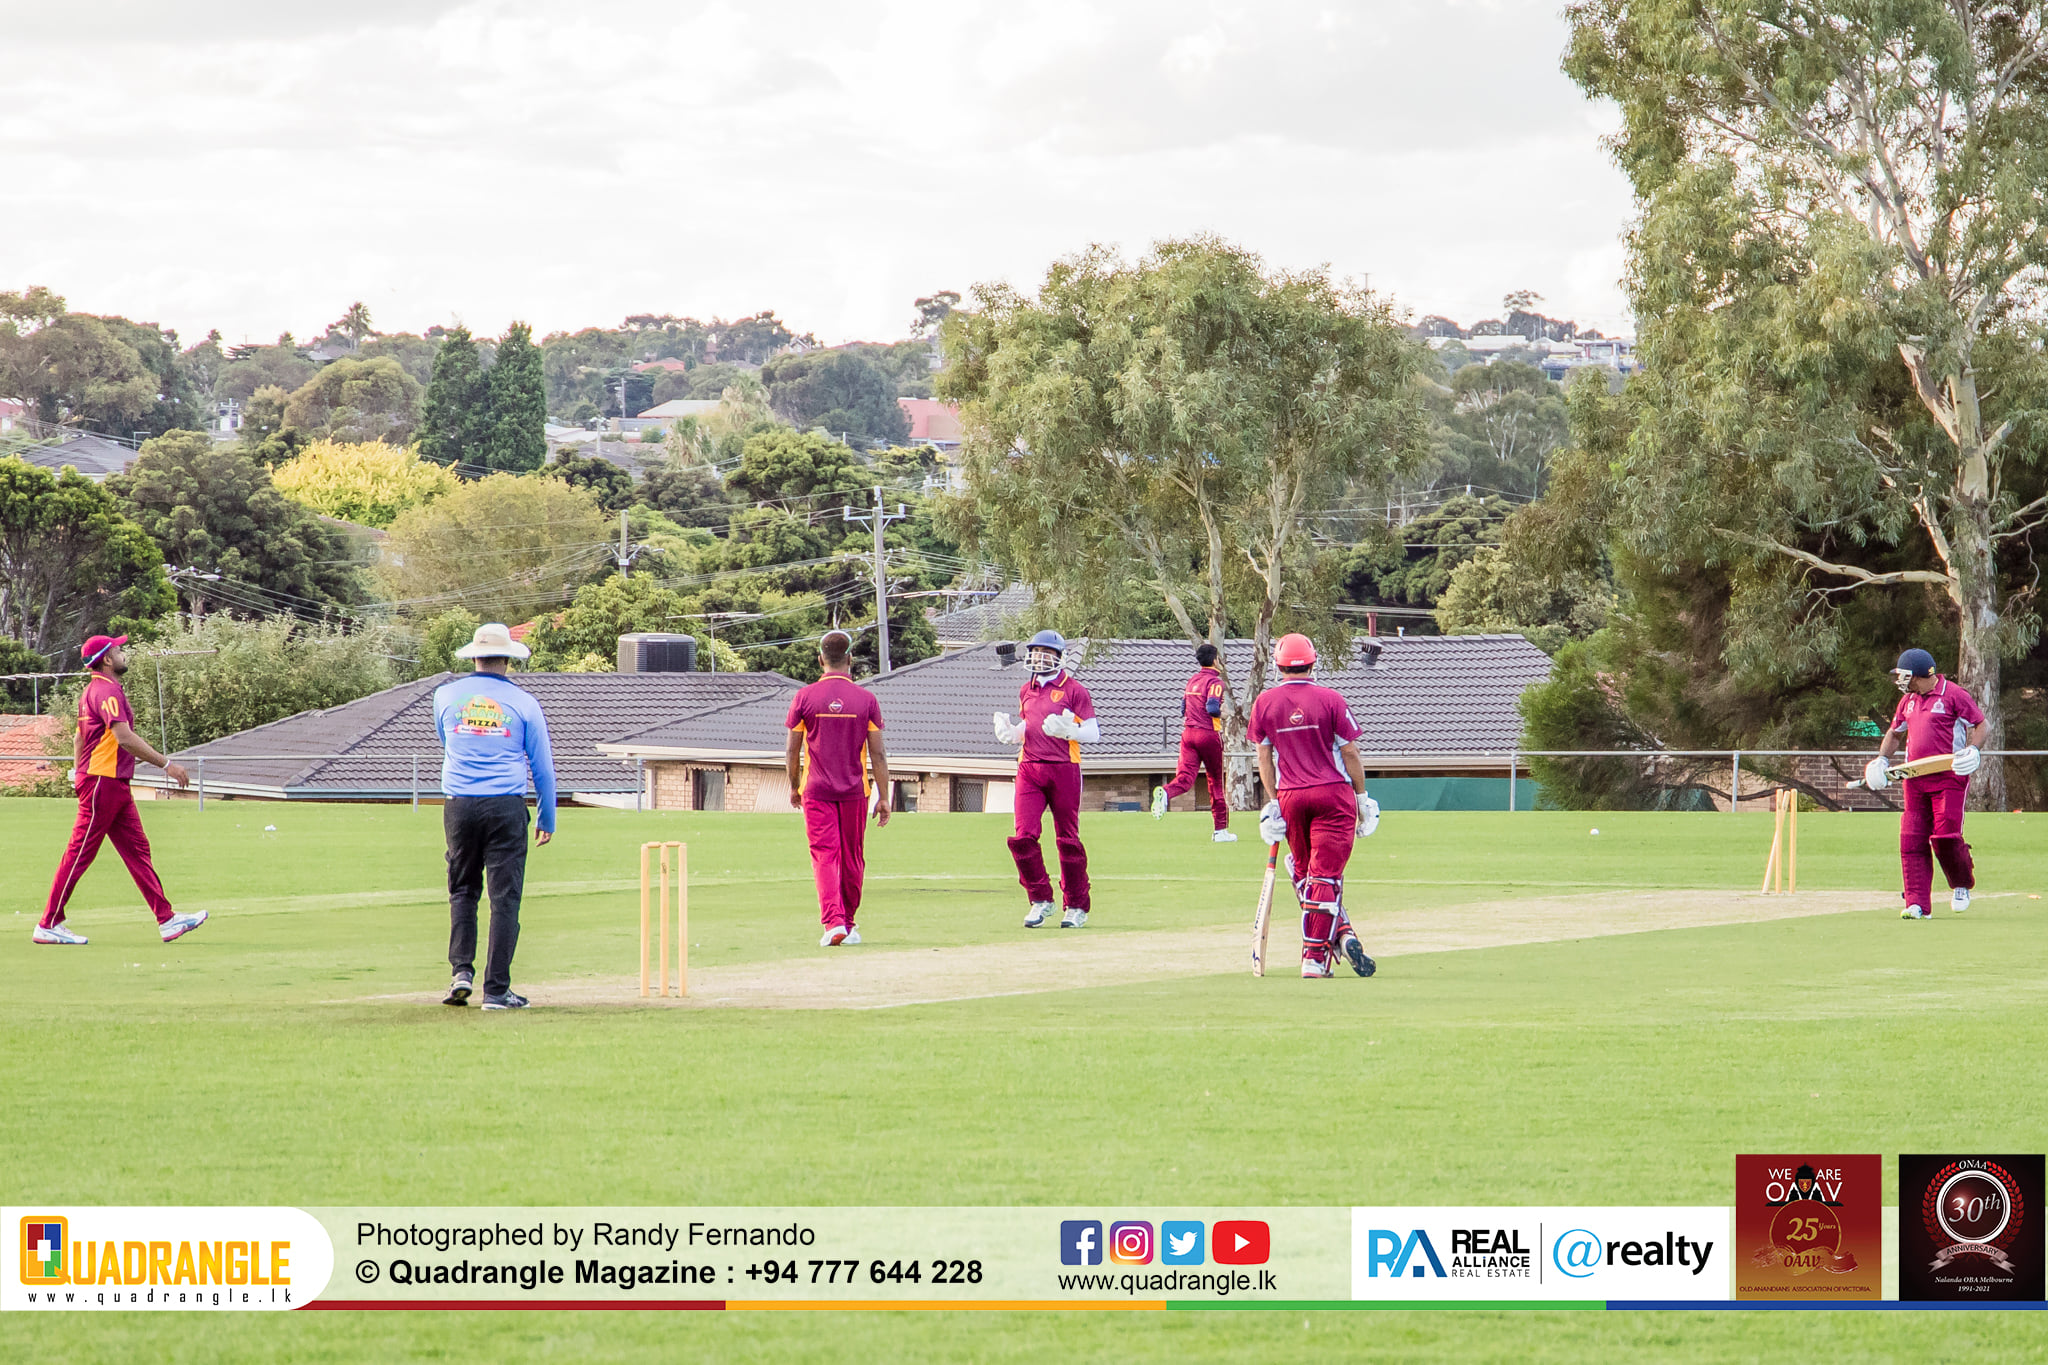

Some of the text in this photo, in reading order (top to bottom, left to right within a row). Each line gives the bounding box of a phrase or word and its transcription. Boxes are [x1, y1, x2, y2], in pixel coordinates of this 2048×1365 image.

[1209, 683, 1222, 697] 10
[101, 696, 119, 717] 10
[455, 708, 513, 725] PARADISE
[467, 719, 498, 728] PIZZA
